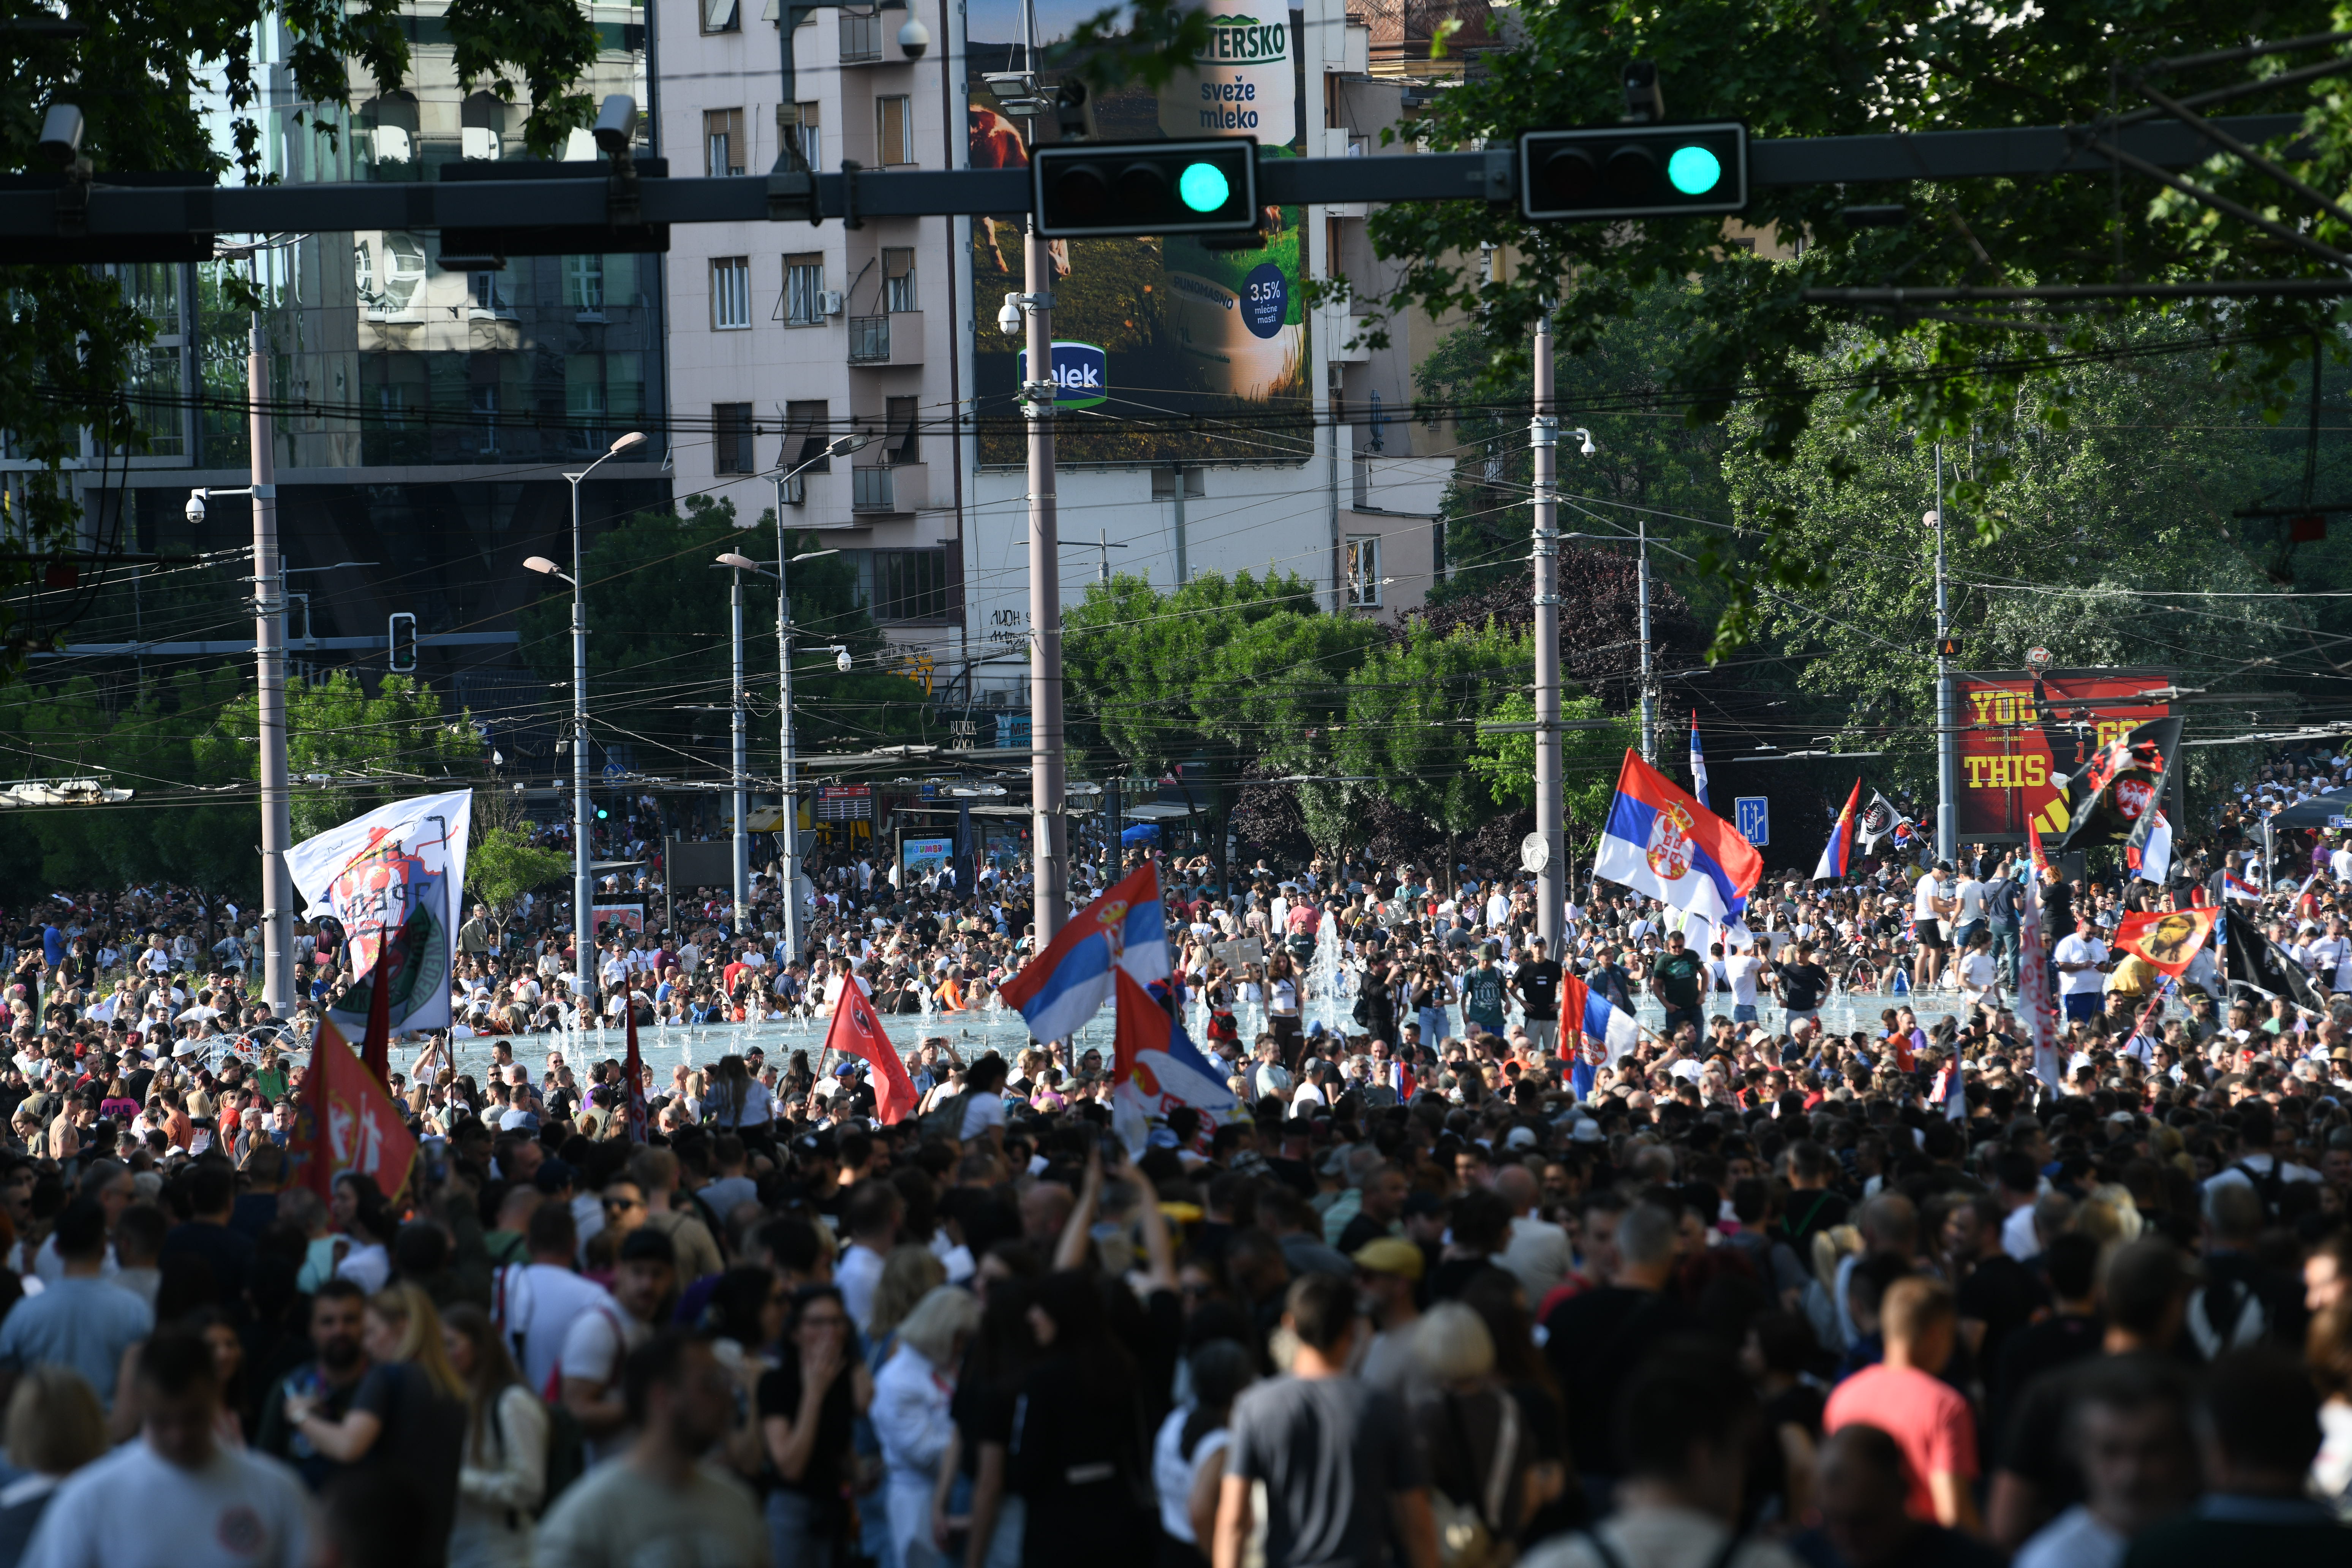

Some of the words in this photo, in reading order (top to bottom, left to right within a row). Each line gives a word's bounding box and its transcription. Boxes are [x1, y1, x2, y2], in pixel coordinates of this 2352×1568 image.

[1167, 9, 1285, 58] PTERSKO
[1201, 75, 1255, 101] sveže
[1200, 103, 1258, 129] mleko
[1174, 276, 1234, 310] PUNOMASNO
[1250, 280, 1280, 303] 3,5%
[1255, 304, 1277, 315] mlečne
[1257, 315, 1276, 324] masti
[1051, 363, 1099, 388] lek
[1970, 692, 2038, 725] YOU
[950, 721, 977, 735] BUREK
[1964, 755, 2046, 788] THIS
[912, 844, 943, 854] JUMBO
